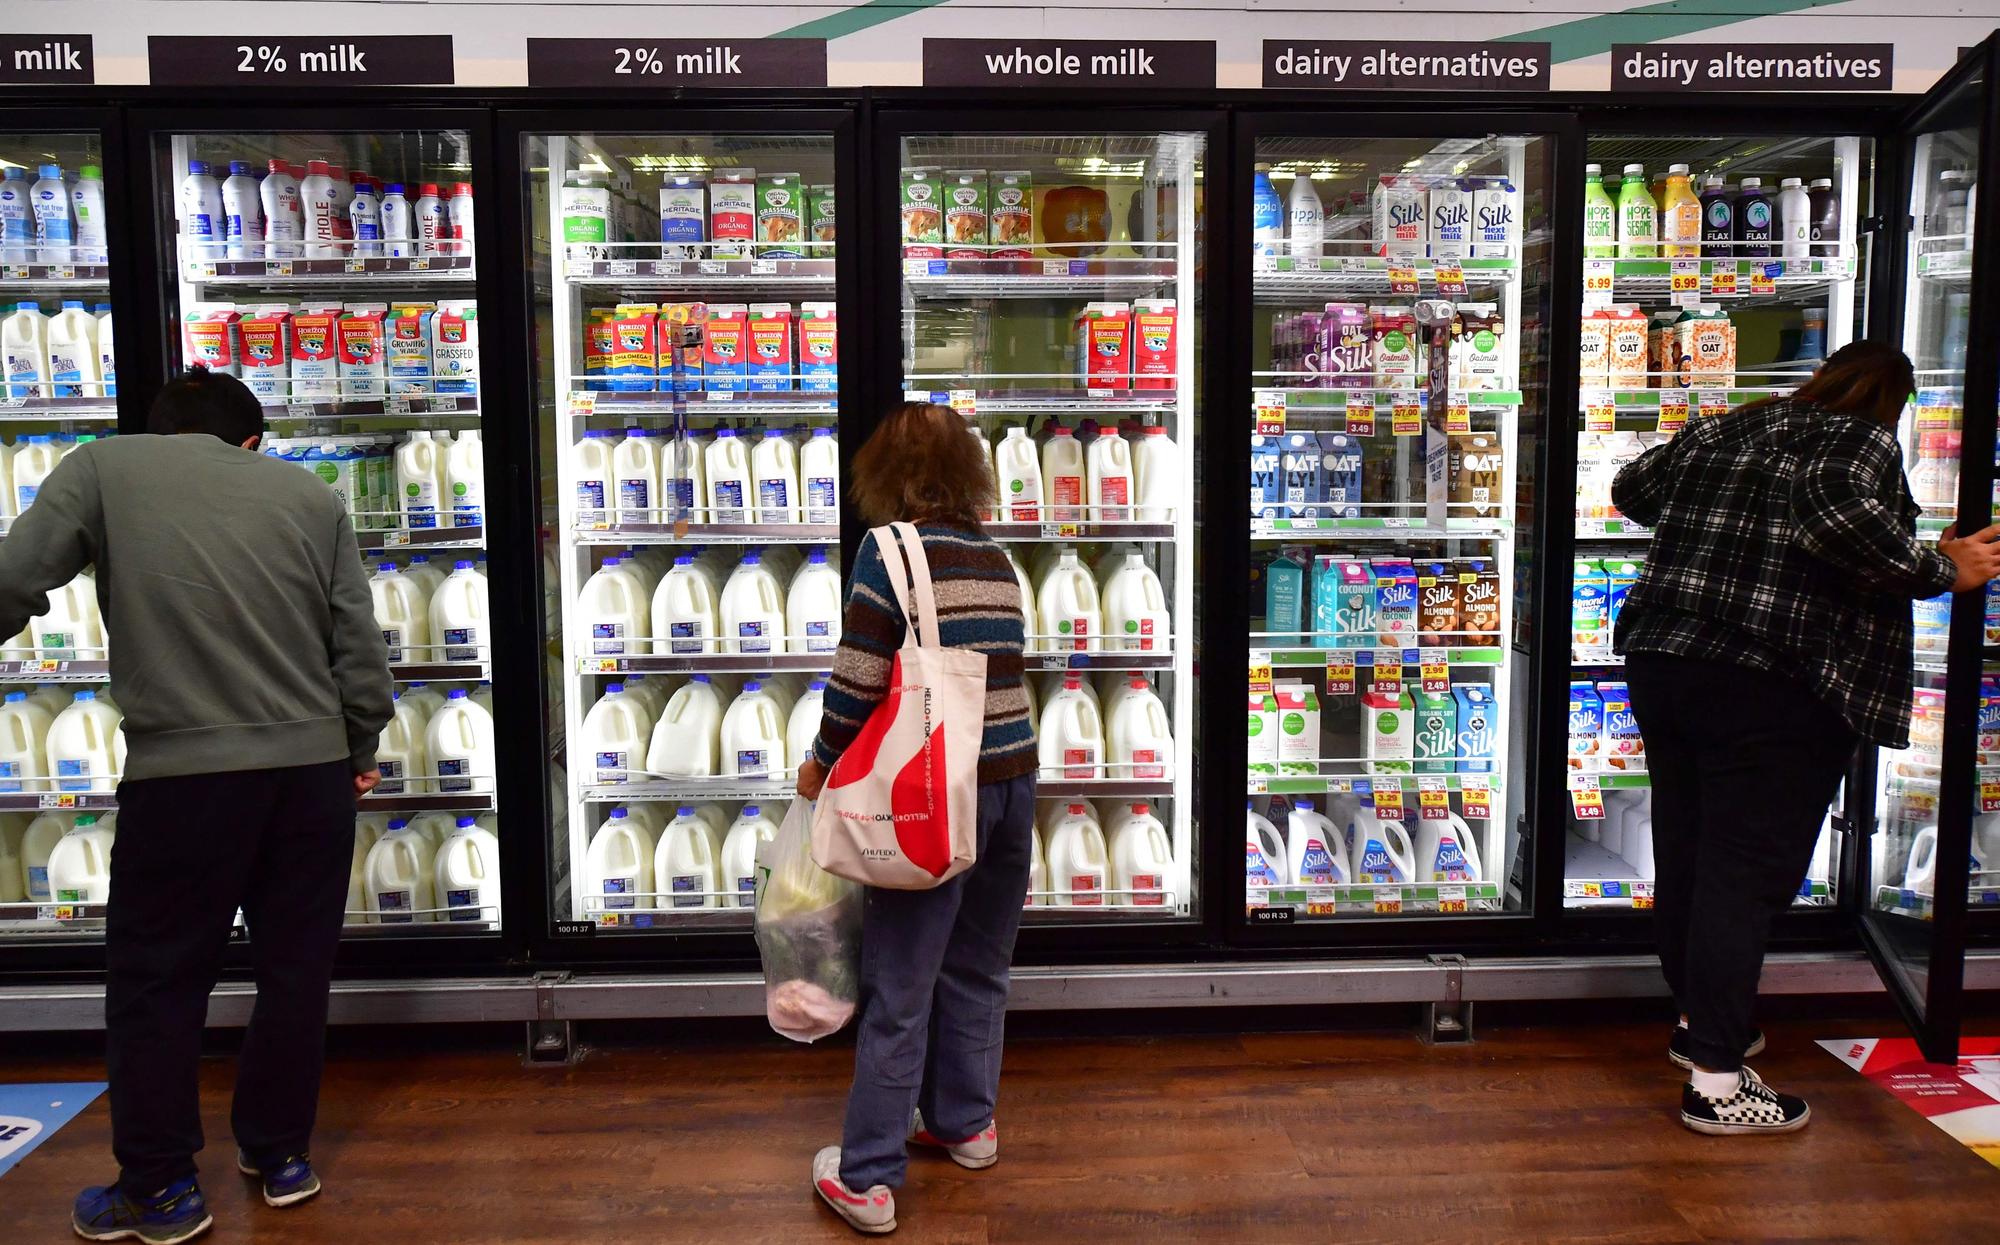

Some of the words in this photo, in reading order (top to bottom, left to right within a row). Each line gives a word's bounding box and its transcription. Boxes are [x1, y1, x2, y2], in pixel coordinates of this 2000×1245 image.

[14, 42, 82, 70] milk
[237, 45, 287, 72] 2%
[300, 45, 367, 72] milk
[614, 48, 663, 74] 2%
[676, 47, 742, 74] milk
[985, 48, 1080, 75] whole
[1091, 48, 1155, 75] milk
[1275, 48, 1351, 82] dairy
[1361, 49, 1538, 77] alternatives
[1624, 52, 1698, 85] dairy
[1708, 52, 1881, 78] alternatives
[713, 201, 752, 209] HERITAGE
[902, 201, 938, 210] GRASSMILK
[947, 205, 984, 214] GRASSMILK
[992, 205, 1029, 214] GRASSMILK
[759, 206, 798, 216] GRASSMILK
[1289, 208, 1323, 222] ripple
[1587, 207, 1610, 220] HOPE
[1626, 207, 1651, 220] HOPE
[1389, 203, 1424, 229] Silk
[1434, 204, 1469, 229] Silk
[1477, 204, 1513, 230] Silk
[1587, 221, 1610, 236] SESAME
[1626, 221, 1652, 236] SESAME
[1396, 231, 1418, 239] milk
[1707, 232, 1729, 240] FLAX
[1746, 232, 1768, 240] FLAX
[1588, 278, 1611, 289] 6.99
[1674, 278, 1698, 289] 6.99
[1714, 275, 1735, 283] 4.69
[1396, 284, 1415, 292] 4.29
[1443, 284, 1462, 292] 4.29
[297, 327, 327, 335] HORIZON
[1142, 325, 1171, 333] HORIZON
[1342, 325, 1363, 336] OAT
[245, 333, 275, 341] HORIZON
[1094, 330, 1123, 338] HORIZON
[391, 339, 426, 348] GROWING
[1581, 344, 1600, 353] OAT
[1619, 344, 1639, 353] OAT
[1701, 344, 1721, 353] OAT
[435, 349, 474, 359] GRASSFED
[1380, 353, 1410, 362] Oatmilk
[1469, 353, 1499, 361] Oatmilk
[1331, 343, 1373, 376] Silk
[1260, 409, 1281, 417] 3.99
[1394, 409, 1418, 417] 2/7.00
[1261, 424, 1280, 433] 3.49
[1350, 424, 1369, 433] 3.49
[1287, 472, 1315, 488] LY!
[1329, 472, 1356, 488] LY!
[1470, 471, 1497, 488] LY!
[1338, 585, 1374, 595] COCONUT
[1464, 582, 1497, 603] Silk
[1381, 585, 1413, 606] Silk
[1423, 586, 1455, 606] Silk
[1424, 607, 1455, 616] ALMOND
[1465, 604, 1496, 612] ALMOND
[1336, 605, 1376, 636] Silk
[1382, 612, 1412, 620] COCONUT
[1248, 668, 1269, 678] 2.79
[1331, 667, 1350, 675] 3.49
[1377, 667, 1397, 675] 3.49
[1425, 666, 1444, 674] 2.99
[1332, 682, 1350, 691] 2.99
[1378, 682, 1397, 691] 2.99
[1427, 682, 1445, 690] 2.49
[924, 688, 932, 714] HELLO
[1569, 710, 1598, 729] Silk
[924, 720, 932, 751] TOKYO
[1569, 732, 1597, 740] ALMOND
[1611, 732, 1640, 740] ALMOND
[1416, 728, 1456, 759] Silk
[1458, 728, 1497, 759] Silk
[1378, 793, 1397, 801] 3.29
[1424, 793, 1444, 801] 3.29
[1466, 792, 1485, 800] 3.29
[1381, 809, 1398, 817] 2.79
[1427, 808, 1444, 817] 2.79
[1468, 807, 1486, 816] 2.79
[1581, 808, 1599, 816] 2.49
[903, 813, 929, 821] HELLO
[862, 848, 897, 856] SHISEIDO
[1305, 852, 1328, 868] Silk
[1364, 853, 1389, 868] Silk
[1438, 849, 1463, 865] Silk
[1311, 904, 1332, 913] 4.89
[1377, 903, 1399, 912] 4.89
[1442, 902, 1464, 911] 4.89
[1848, 1044, 1865, 1059] NEW
